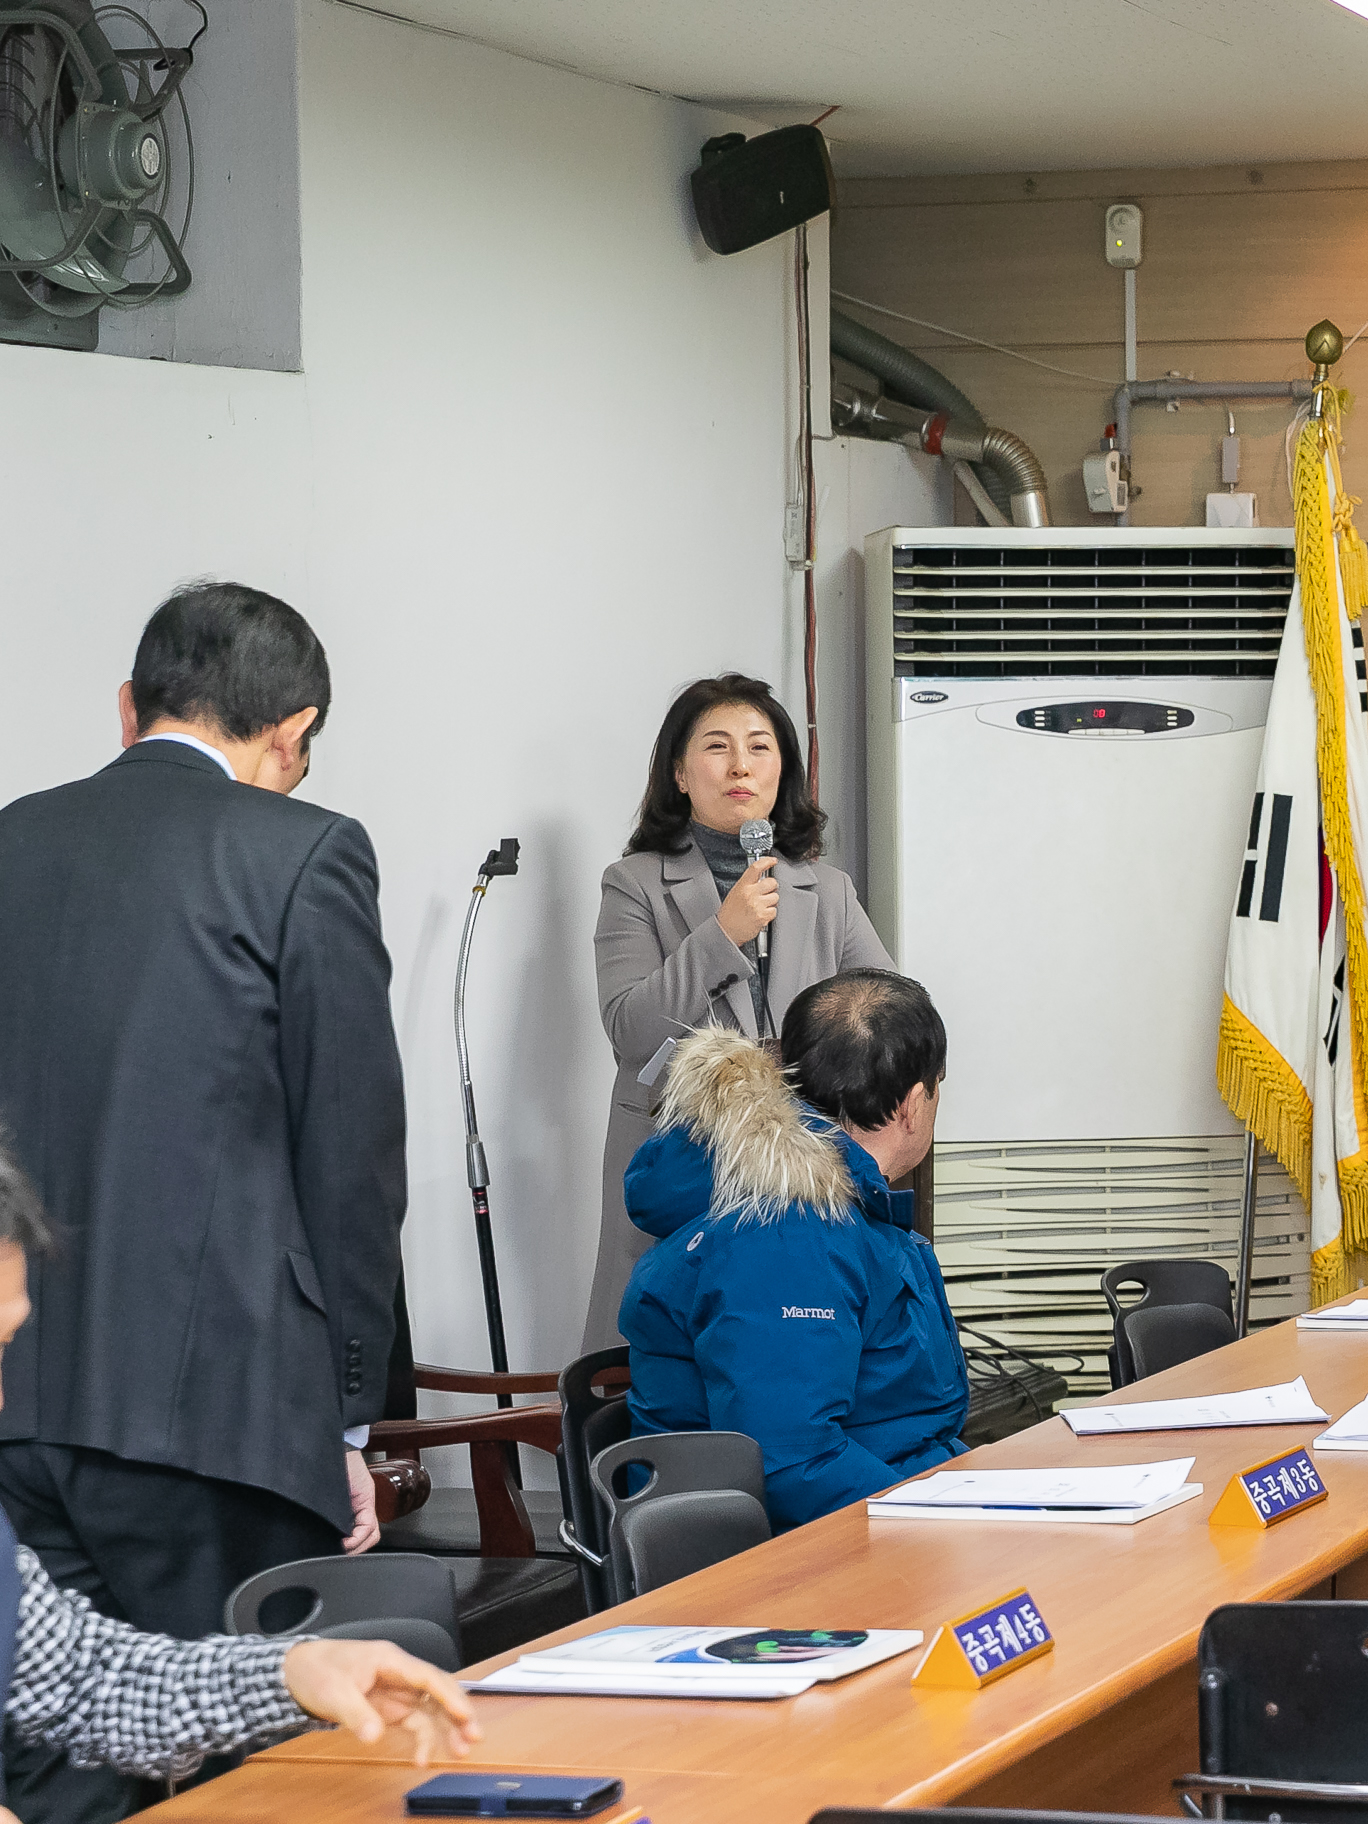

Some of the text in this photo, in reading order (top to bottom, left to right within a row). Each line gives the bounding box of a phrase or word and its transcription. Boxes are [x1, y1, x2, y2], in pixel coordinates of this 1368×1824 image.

[913, 692, 946, 702] Carrier
[781, 1305, 836, 1321] Marmot
[1249, 1458, 1320, 1515] 중곡제3동
[961, 1603, 1046, 1672] 중곡제4동
